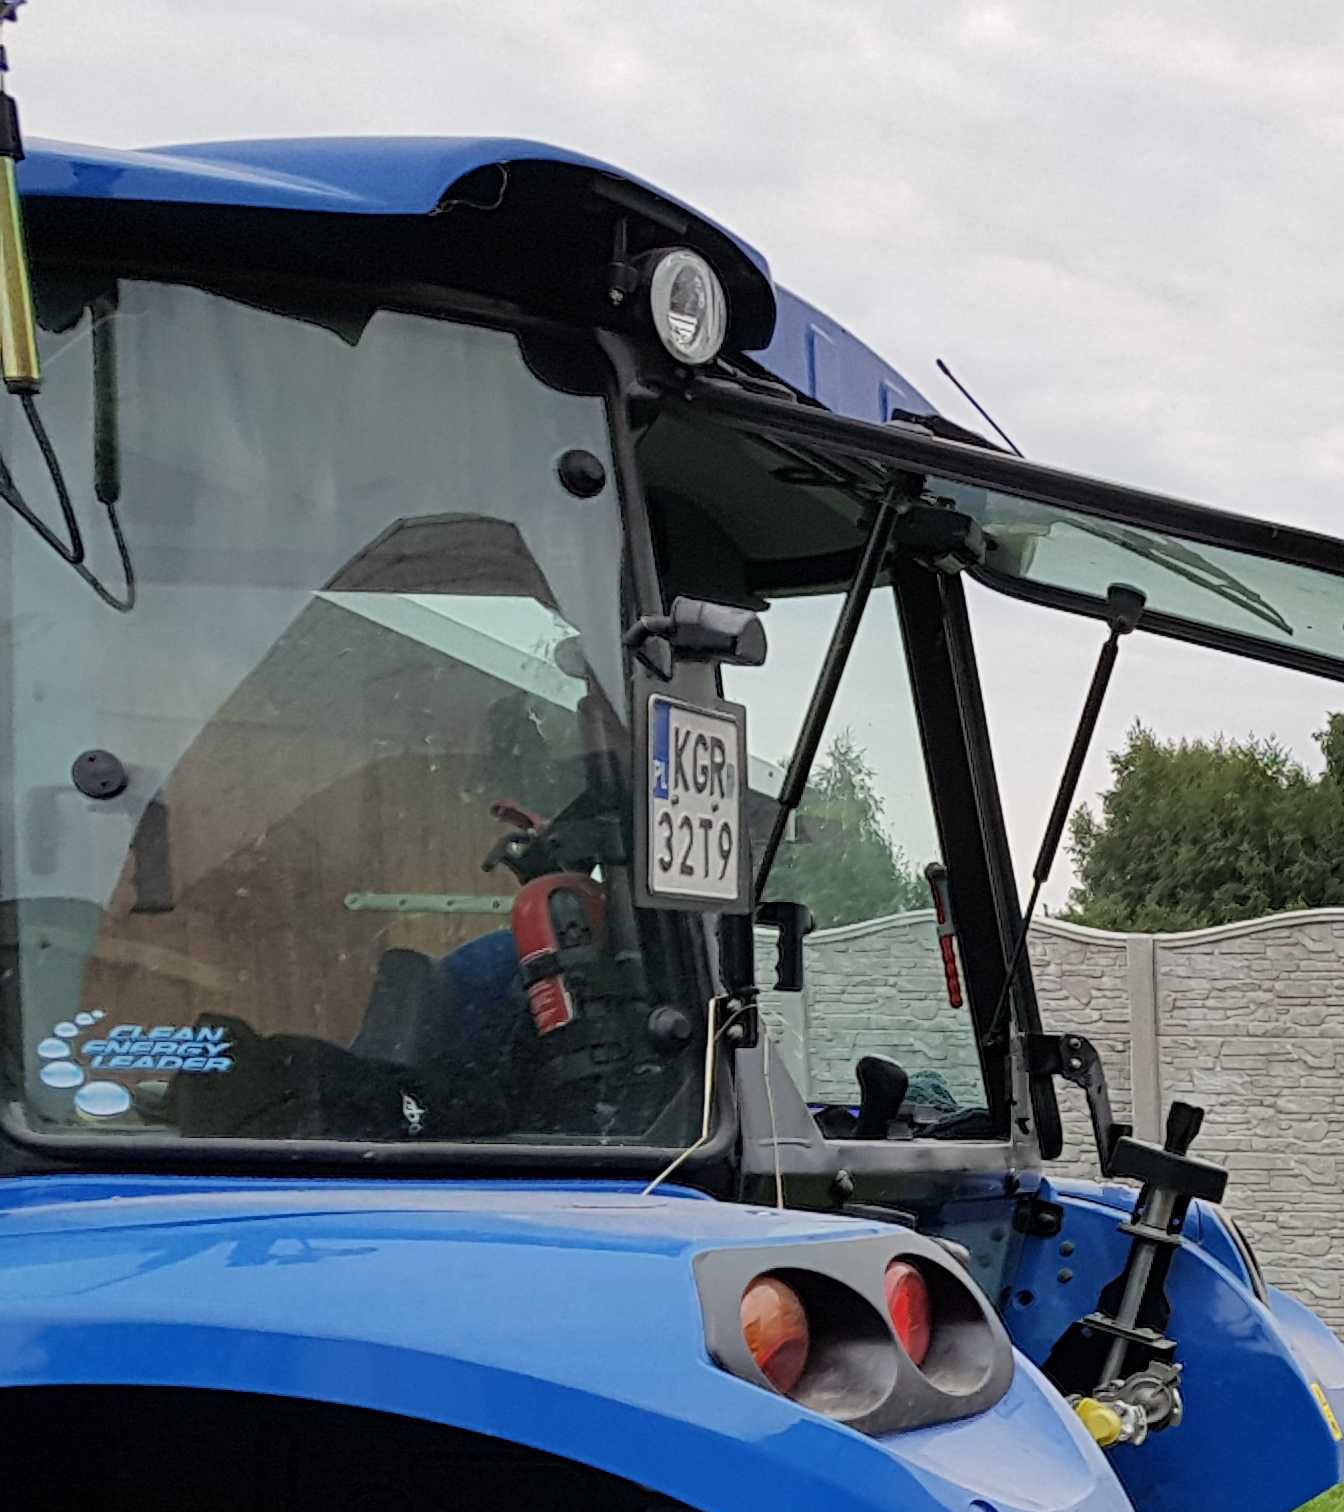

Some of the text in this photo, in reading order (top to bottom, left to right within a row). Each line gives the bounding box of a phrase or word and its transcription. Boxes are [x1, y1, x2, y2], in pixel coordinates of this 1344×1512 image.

[673, 727, 726, 800] KGR
[658, 811, 733, 881] 32T9
[108, 1023, 224, 1041] CLEAN
[81, 1039, 234, 1057] ENERGY
[91, 1055, 234, 1072] LEADER
